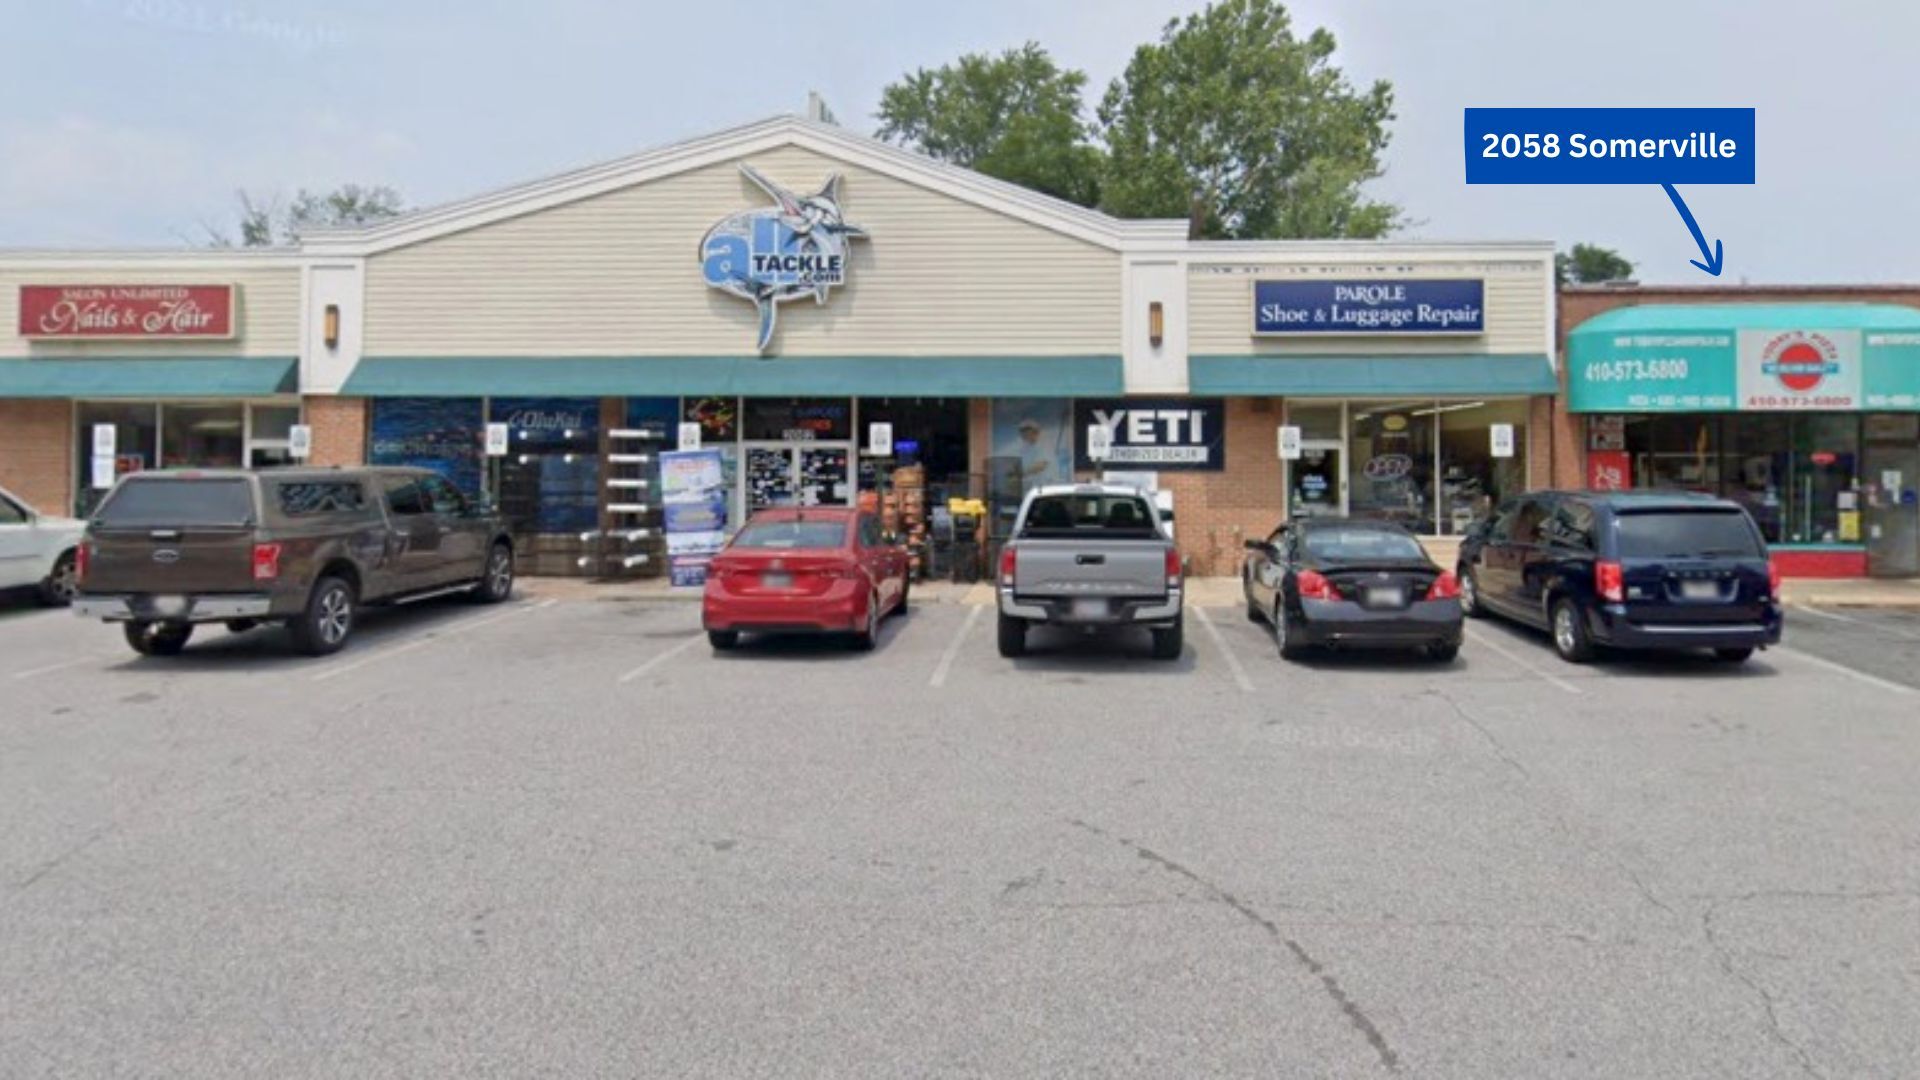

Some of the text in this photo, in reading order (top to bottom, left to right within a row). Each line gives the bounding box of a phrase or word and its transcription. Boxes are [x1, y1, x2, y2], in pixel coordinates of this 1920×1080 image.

[753, 255, 841, 272] TACKLE
[1335, 285, 1406, 304] PAROLE
[40, 299, 213, 332] Nails & Hair
[1261, 304, 1480, 327] Shoe & Luggage Repair
[1091, 410, 1201, 443] YETI
[1109, 448, 1160, 460] UTHORIZED
